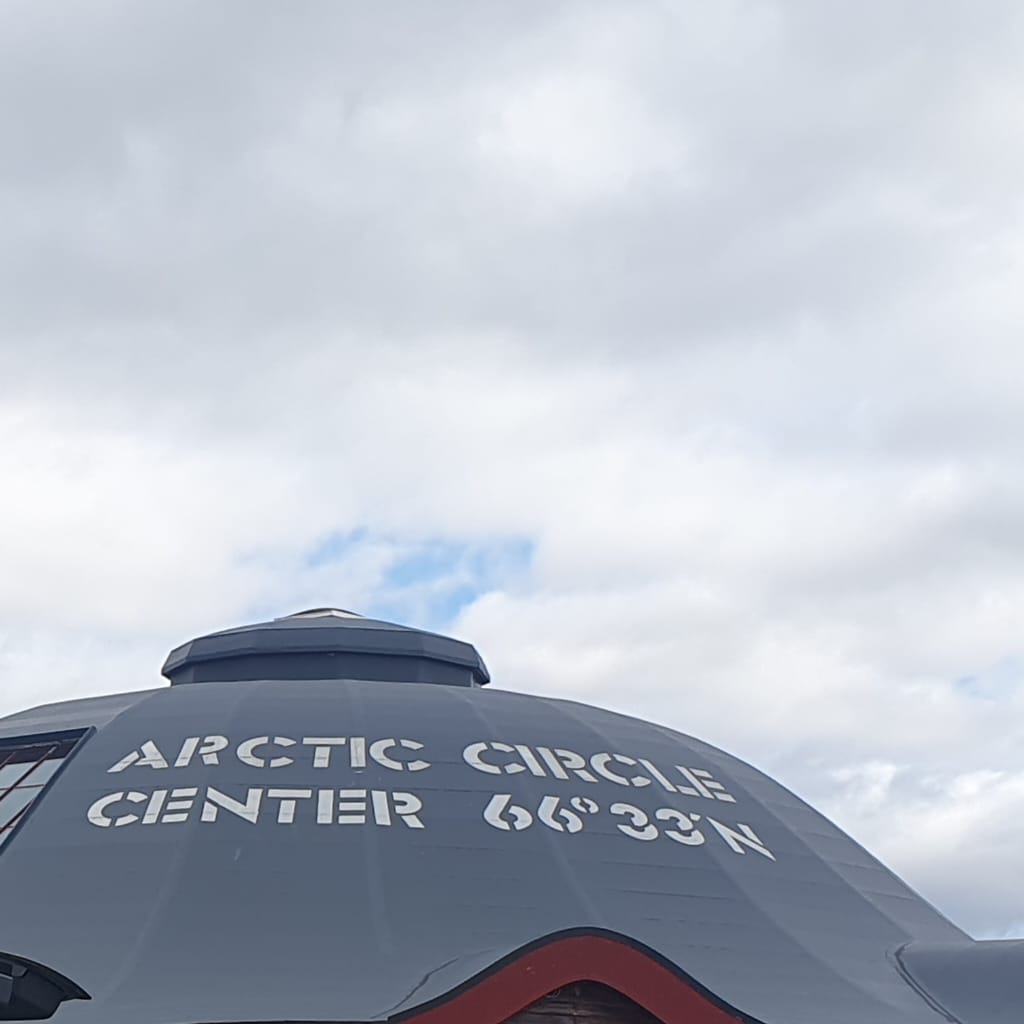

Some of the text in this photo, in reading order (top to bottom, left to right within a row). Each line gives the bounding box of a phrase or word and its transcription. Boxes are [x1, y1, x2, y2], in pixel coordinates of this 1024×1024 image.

[107, 735, 737, 803] ARCTIC CIRCLE
[86, 786, 426, 829] CENTER
